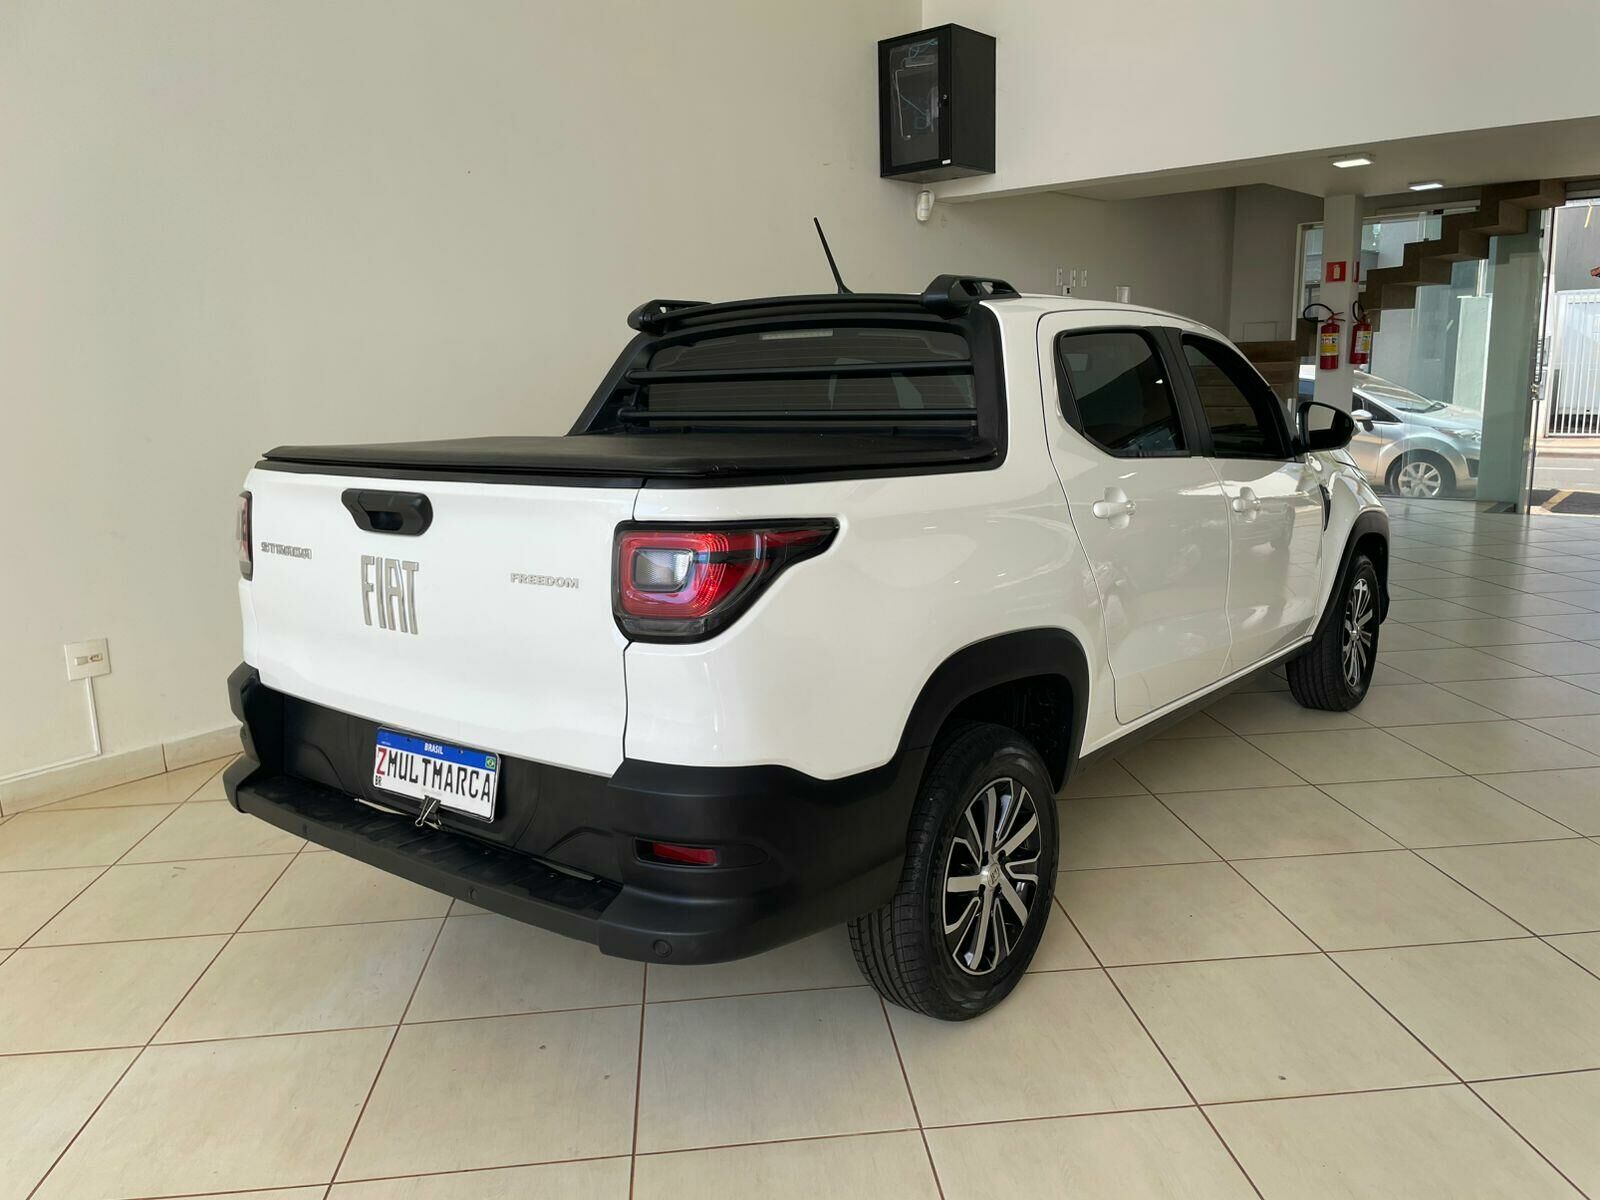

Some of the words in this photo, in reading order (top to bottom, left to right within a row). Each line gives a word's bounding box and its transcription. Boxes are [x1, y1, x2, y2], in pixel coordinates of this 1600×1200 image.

[510, 573, 580, 589] FREEDOM
[360, 554, 419, 635] FIAT
[424, 742, 444, 755] BRASIL
